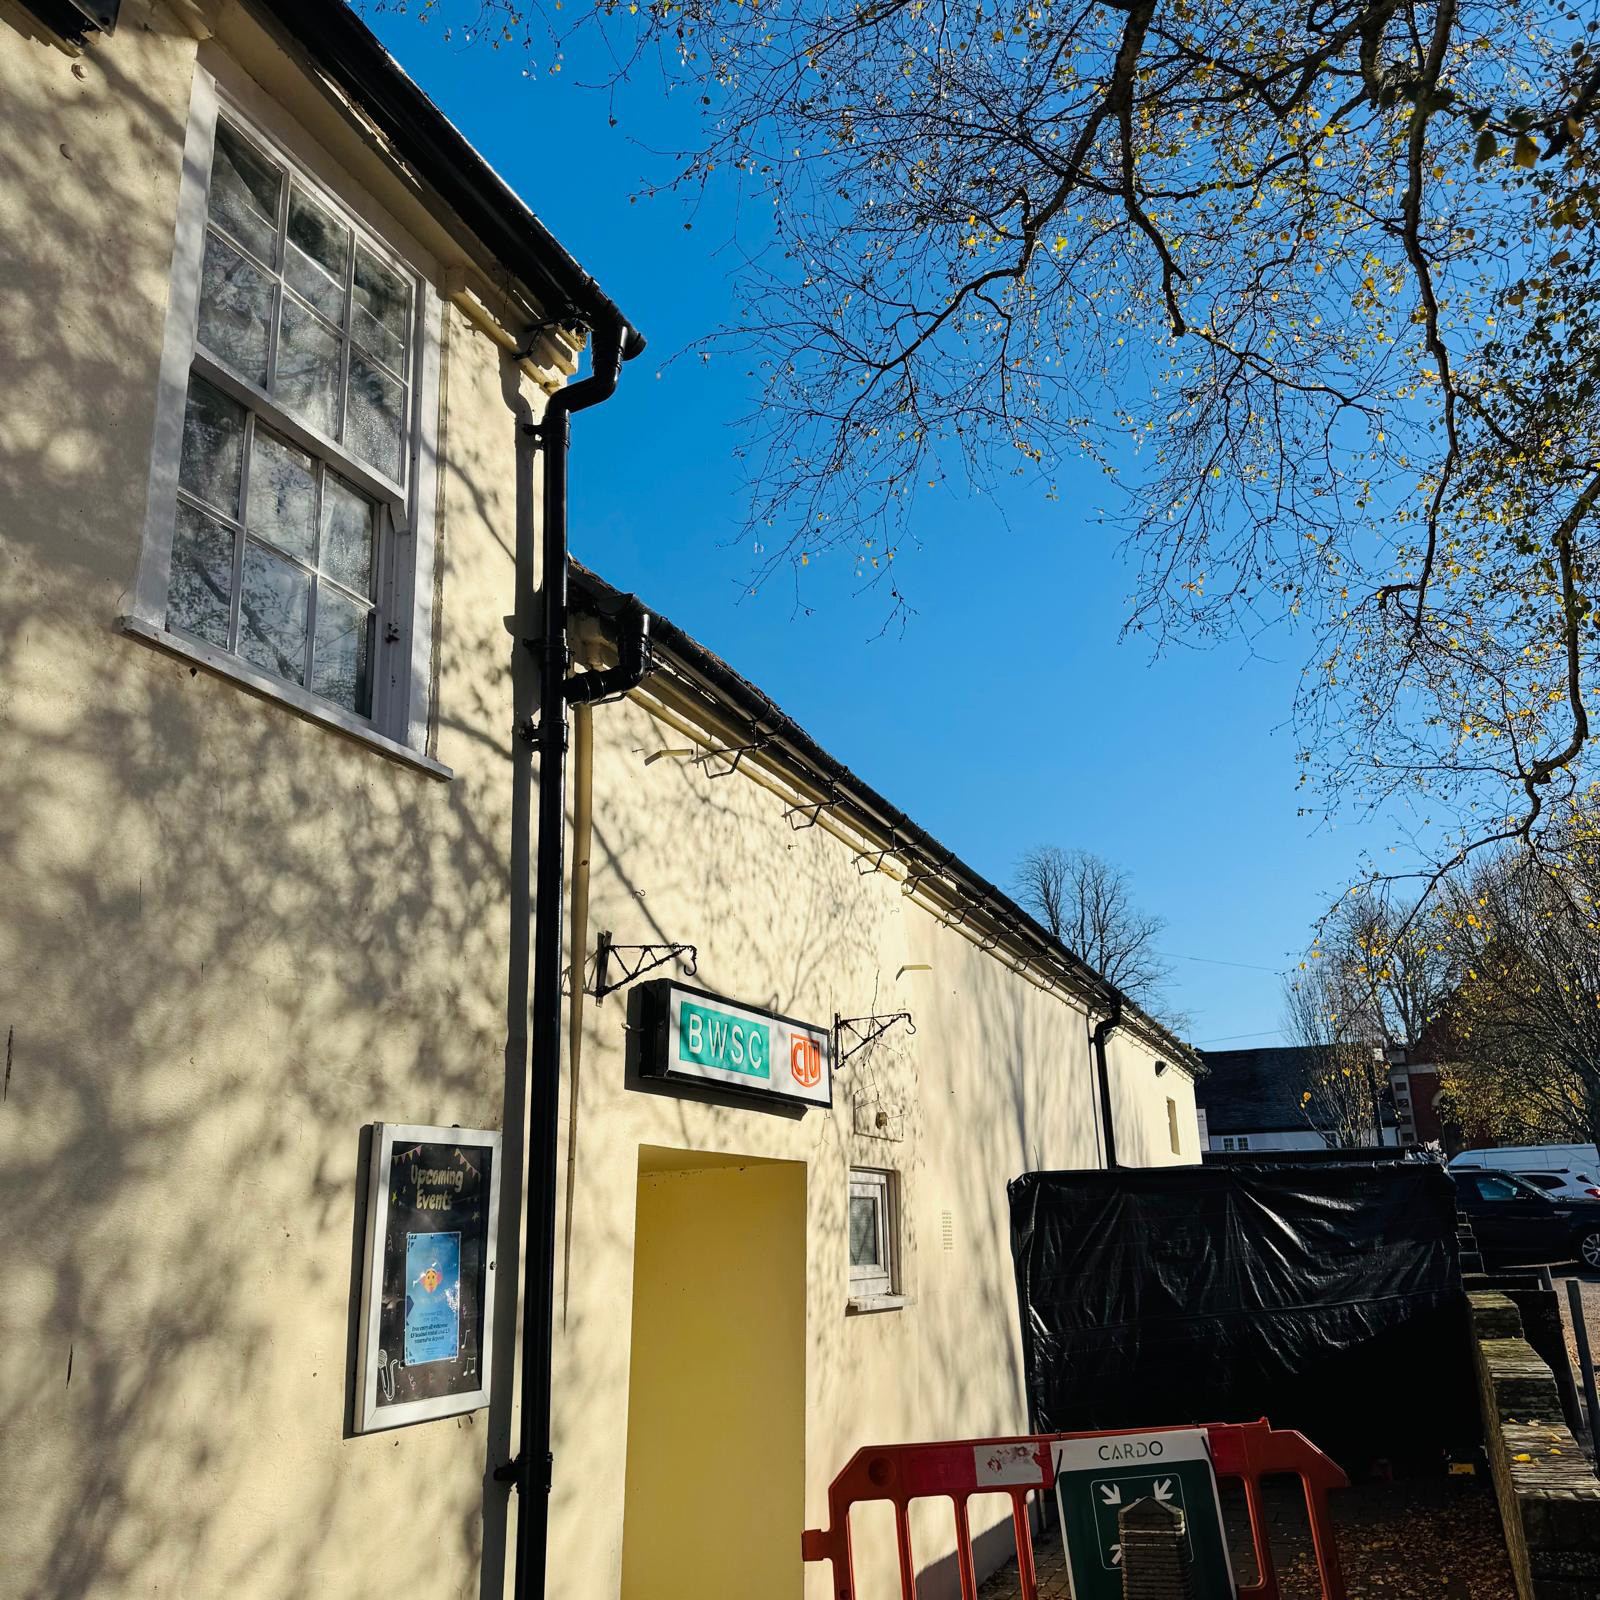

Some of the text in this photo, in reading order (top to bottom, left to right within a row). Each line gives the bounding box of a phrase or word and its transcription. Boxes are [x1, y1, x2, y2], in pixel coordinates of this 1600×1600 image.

[688, 1013, 763, 1069] BWSC
[792, 1039, 821, 1084] CIU
[410, 1164, 464, 1193] Upcoming
[416, 1188, 453, 1211] Events
[1098, 1440, 1164, 1461] CARDO
